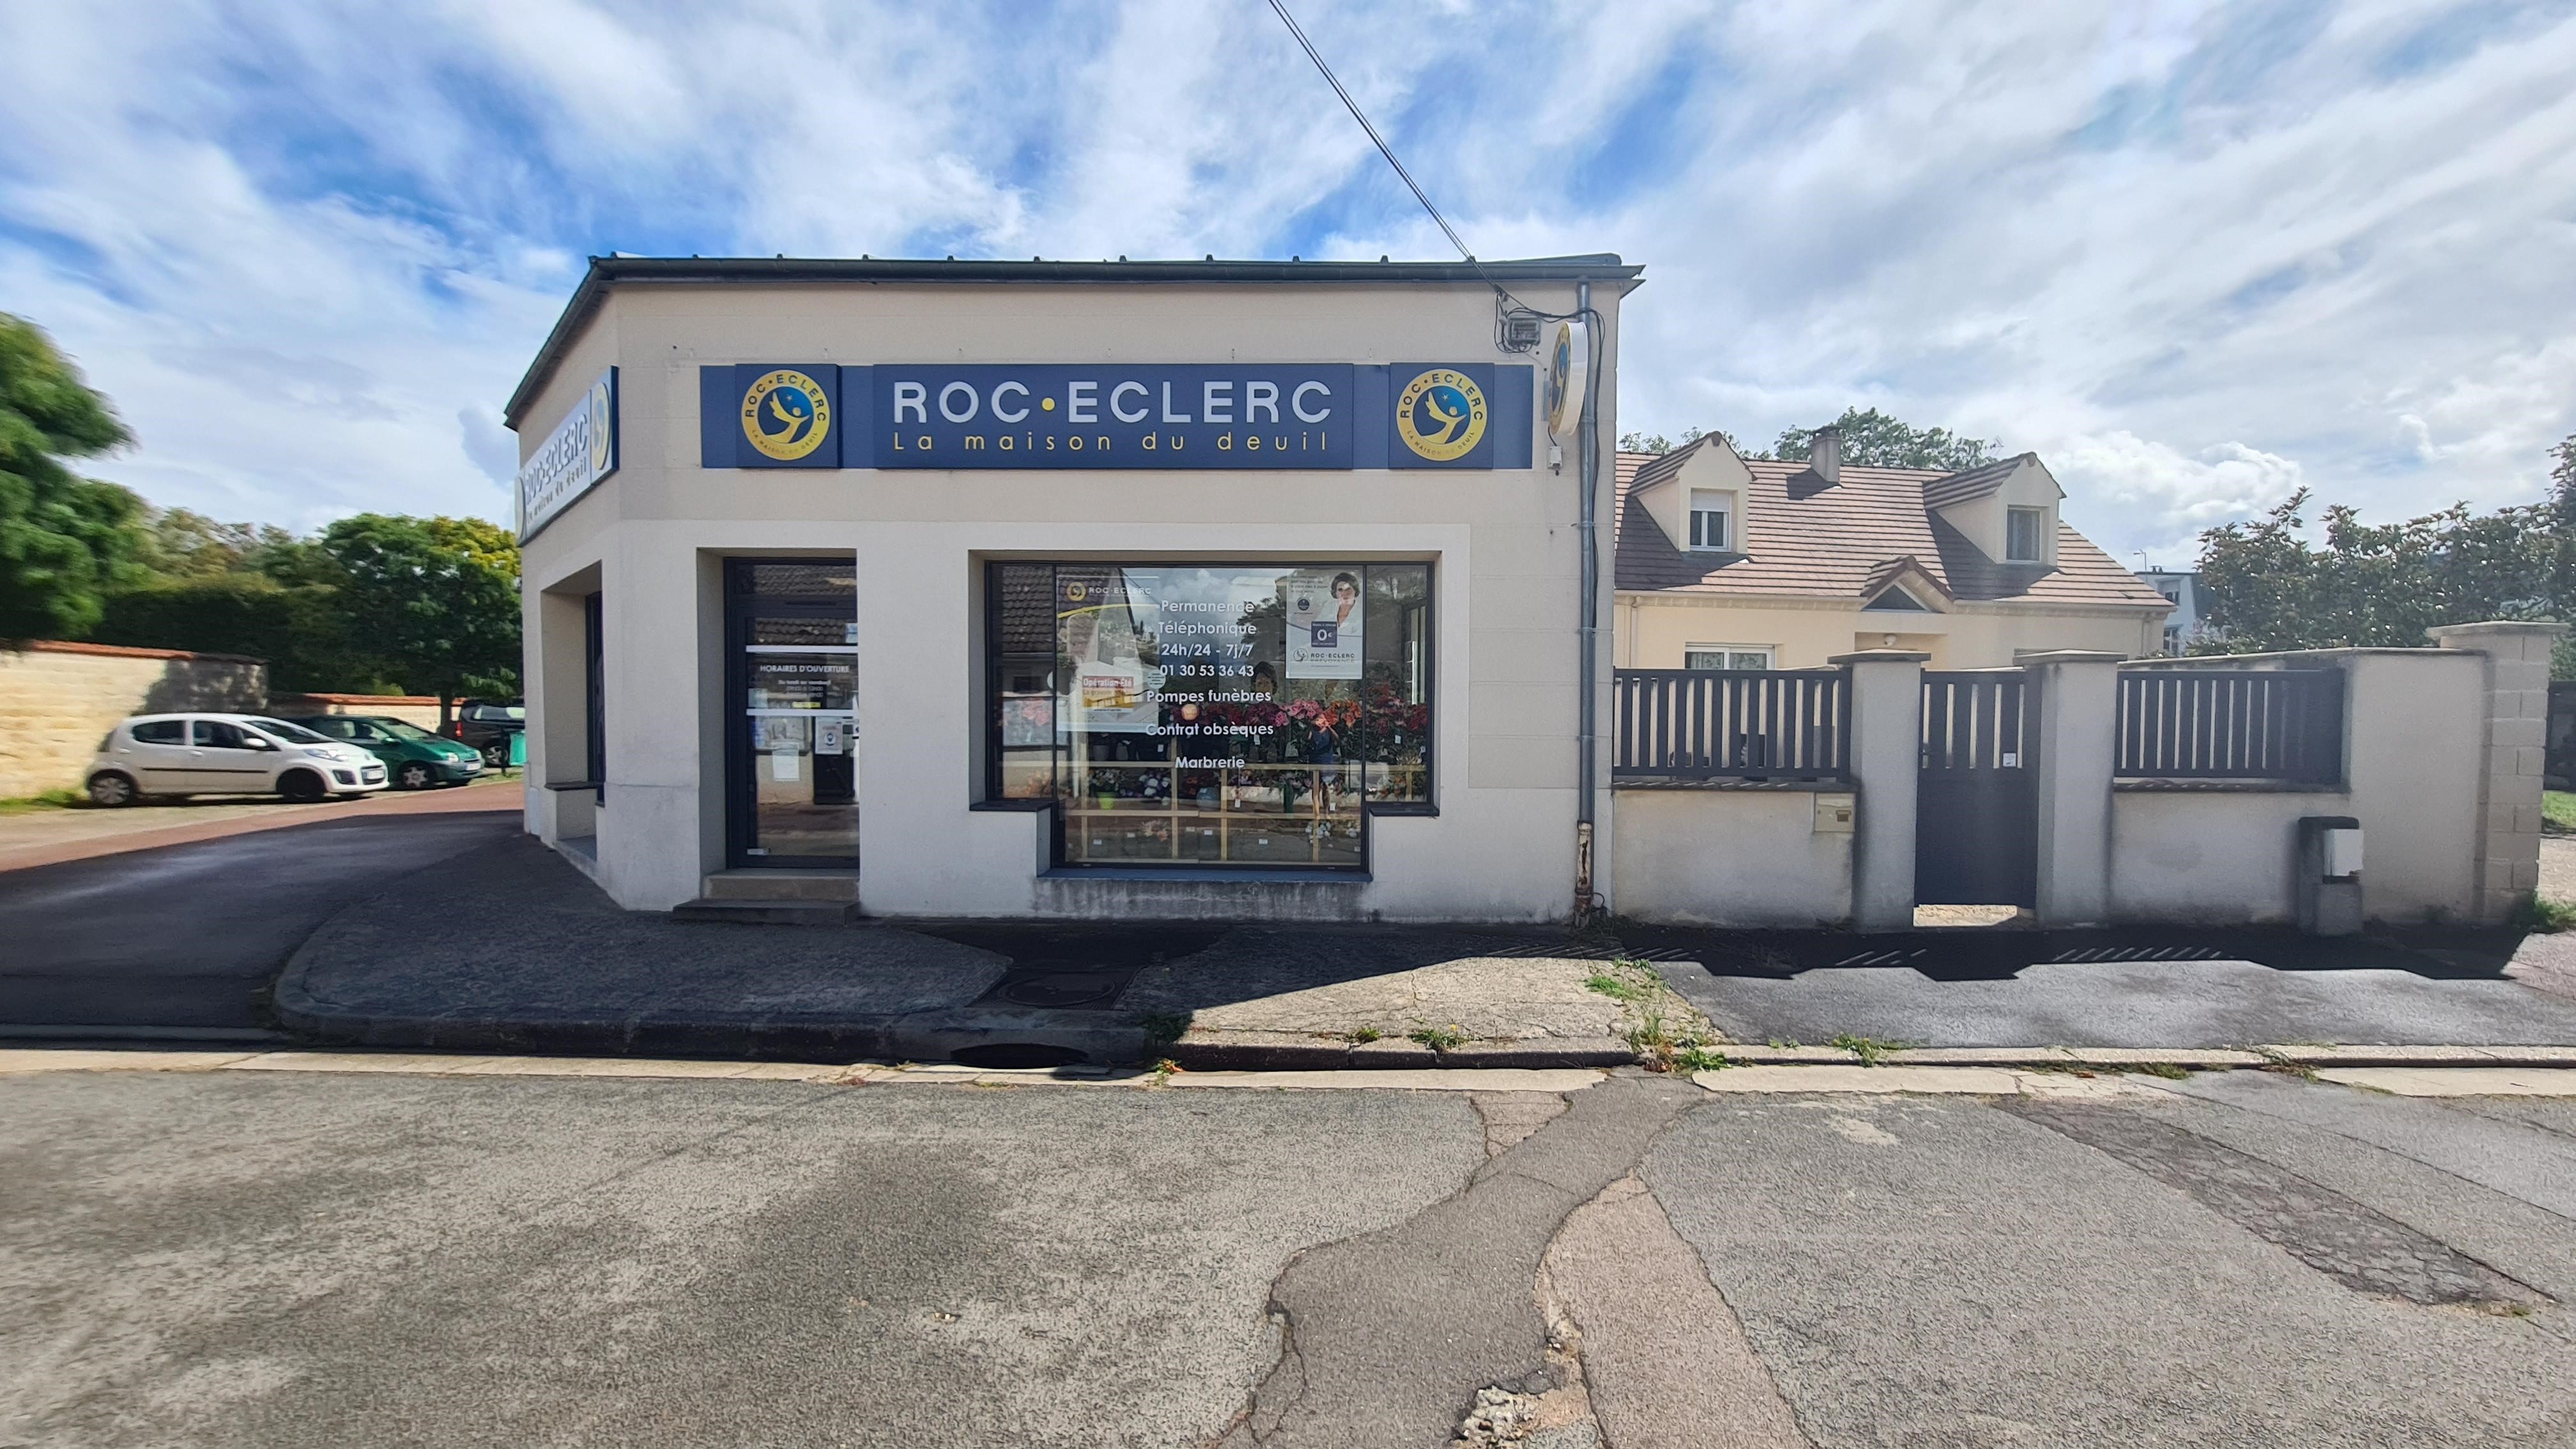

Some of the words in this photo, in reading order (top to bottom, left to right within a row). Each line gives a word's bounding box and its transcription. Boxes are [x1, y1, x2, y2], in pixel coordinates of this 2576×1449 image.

[894, 432, 932, 450] La
[965, 432, 1110, 450] maison
[1142, 431, 1184, 451] du
[1217, 431, 1327, 451] deuil
[1161, 599, 1255, 613] Permanence
[1158, 620, 1257, 636] Téléphonique
[1161, 643, 1211, 657] 24h/24
[1225, 643, 1254, 659] 7j/7
[799, 665, 850, 673] D'OUVERTURE
[1160, 665, 1174, 677] 01
[1179, 665, 1195, 677] 30
[1199, 665, 1215, 677] 53
[1218, 665, 1234, 677] 36
[1238, 665, 1255, 677] 43
[1083, 677, 1118, 688] Opération
[1120, 677, 1132, 687] Été
[1147, 690, 1204, 705] Pompes
[1208, 688, 1271, 702] funèbres
[1146, 723, 1200, 735] Contrat
[1203, 721, 1274, 737] obsèques
[1175, 756, 1245, 769] Marbrerie
